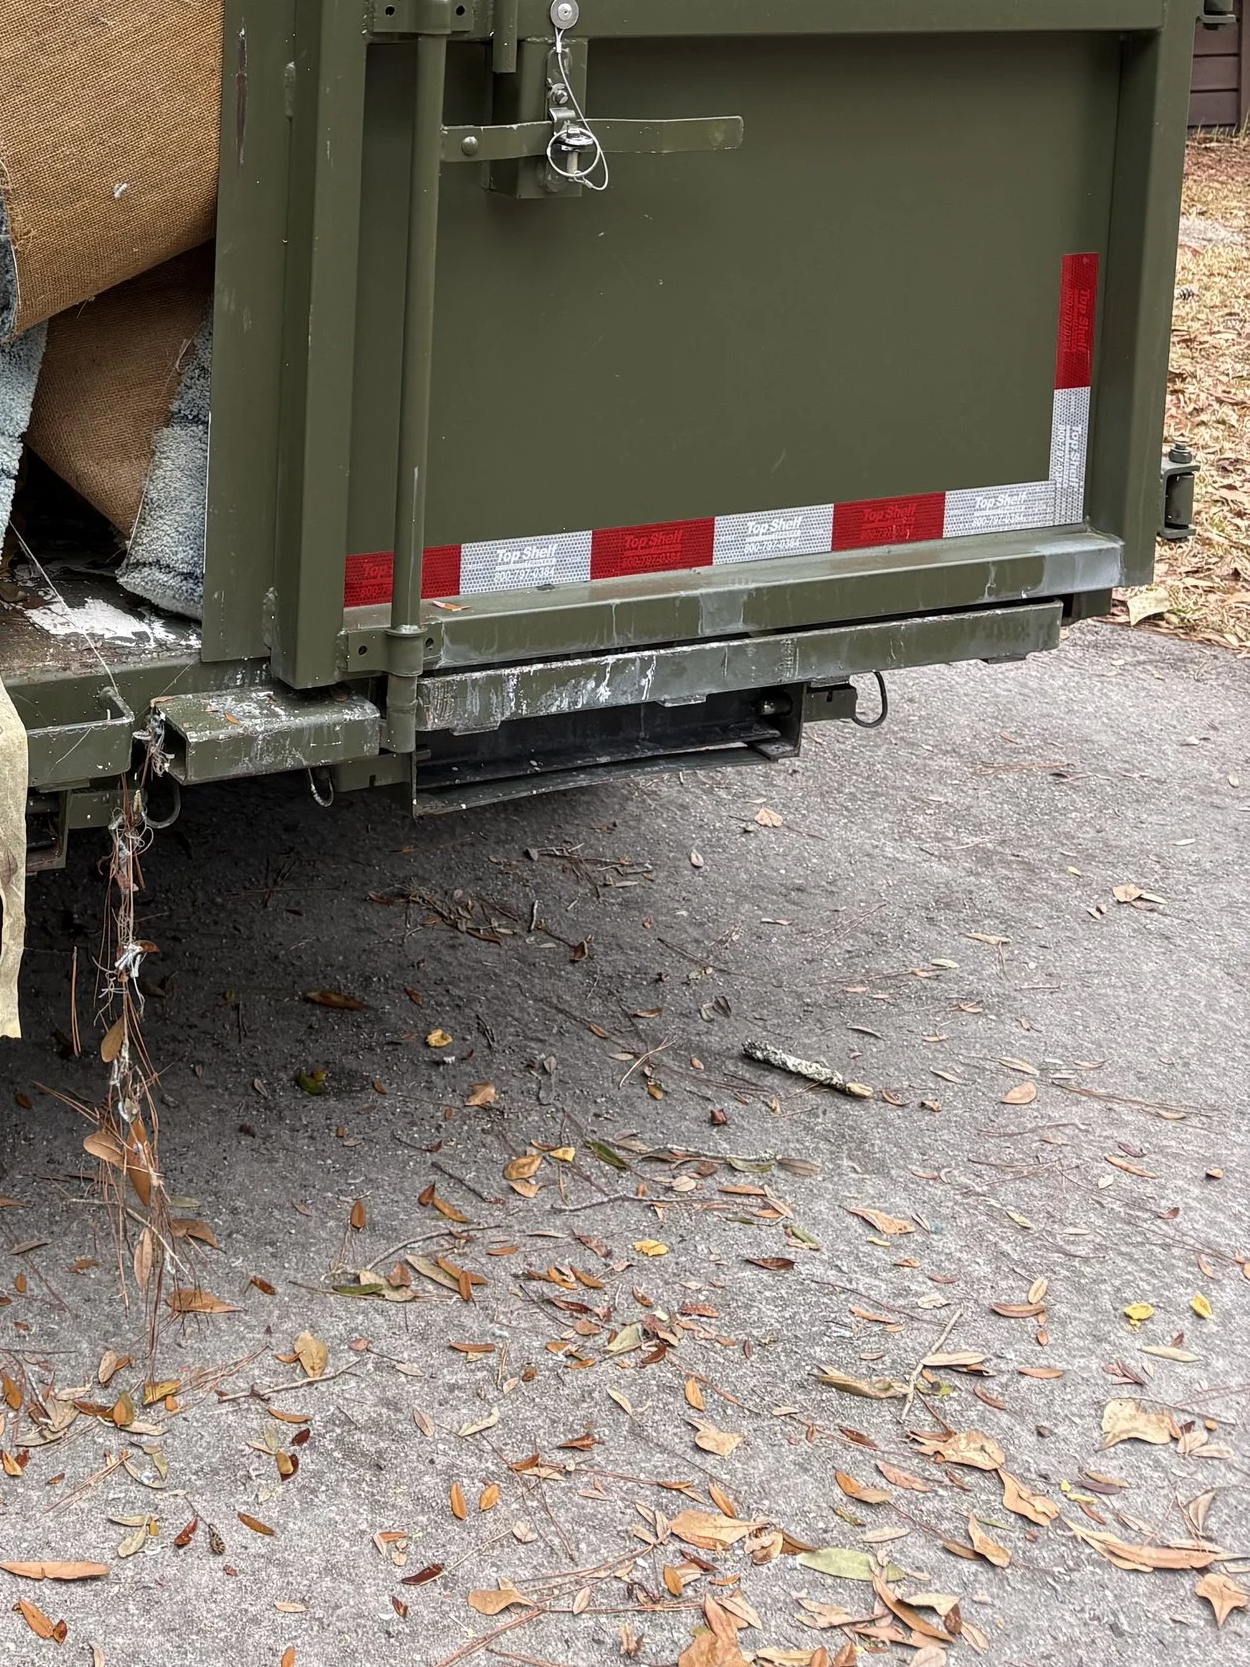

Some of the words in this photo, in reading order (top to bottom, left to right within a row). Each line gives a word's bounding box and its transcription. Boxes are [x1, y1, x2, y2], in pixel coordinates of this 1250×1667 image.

[1077, 289, 1091, 314] Top
[1076, 317, 1090, 354] Shelf
[1069, 424, 1082, 449] Top
[1069, 451, 1081, 488] Shelf
[975, 497, 995, 511] Top
[996, 492, 1027, 507] Shelf
[862, 508, 884, 523] Top
[885, 502, 918, 518] Shelf
[747, 521, 768, 537] Top
[769, 516, 803, 531] Shelf
[624, 535, 648, 550] Top
[649, 529, 684, 545] Shelf
[744, 538, 800, 553] 800-797-0384
[497, 549, 521, 565] Top
[522, 543, 558, 560] Shelf
[363, 563, 387, 579] Top
[494, 566, 555, 582] 800-797-0384
